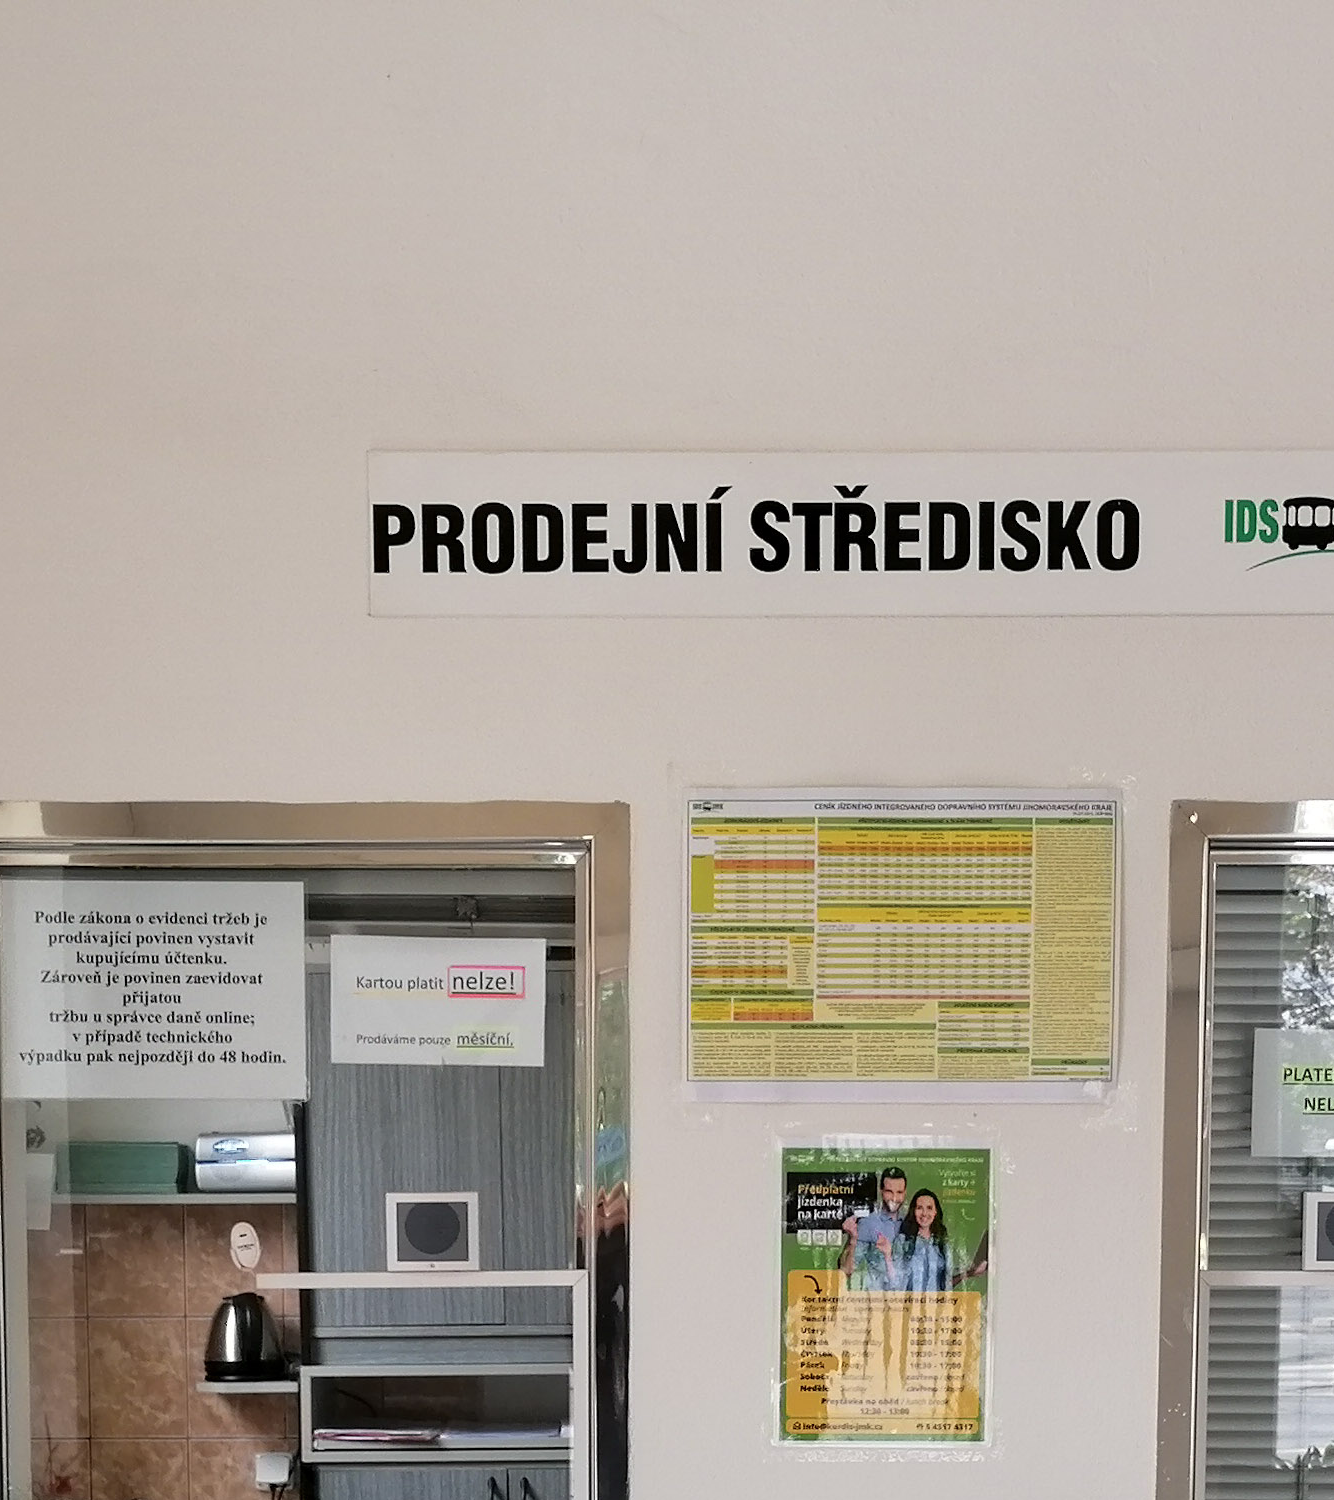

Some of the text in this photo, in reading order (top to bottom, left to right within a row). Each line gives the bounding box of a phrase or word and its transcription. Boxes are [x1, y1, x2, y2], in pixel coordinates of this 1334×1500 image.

[371, 484, 1141, 573] PRODEJNÍ STŘEDISKO
[1224, 499, 1279, 543] IDS
[34, 911, 267, 928] Podle zákona o evidenci tržeb je
[48, 931, 254, 947] prodávající povinen vystavit
[76, 951, 227, 967] kupujícímu účtenku.
[40, 971, 263, 987] Zároveň je povinen zaevidovat
[356, 971, 515, 992] Kartou platit nelze!
[123, 991, 181, 1006] přijatou
[49, 1011, 255, 1026] tržbu u správce daně online;
[72, 1031, 233, 1046] v případě technického
[356, 1033, 416, 1045] Prodáváme
[419, 1037, 451, 1048] pouze
[19, 1050, 287, 1066] výpadku pak nejpozději do 48 hodin.
